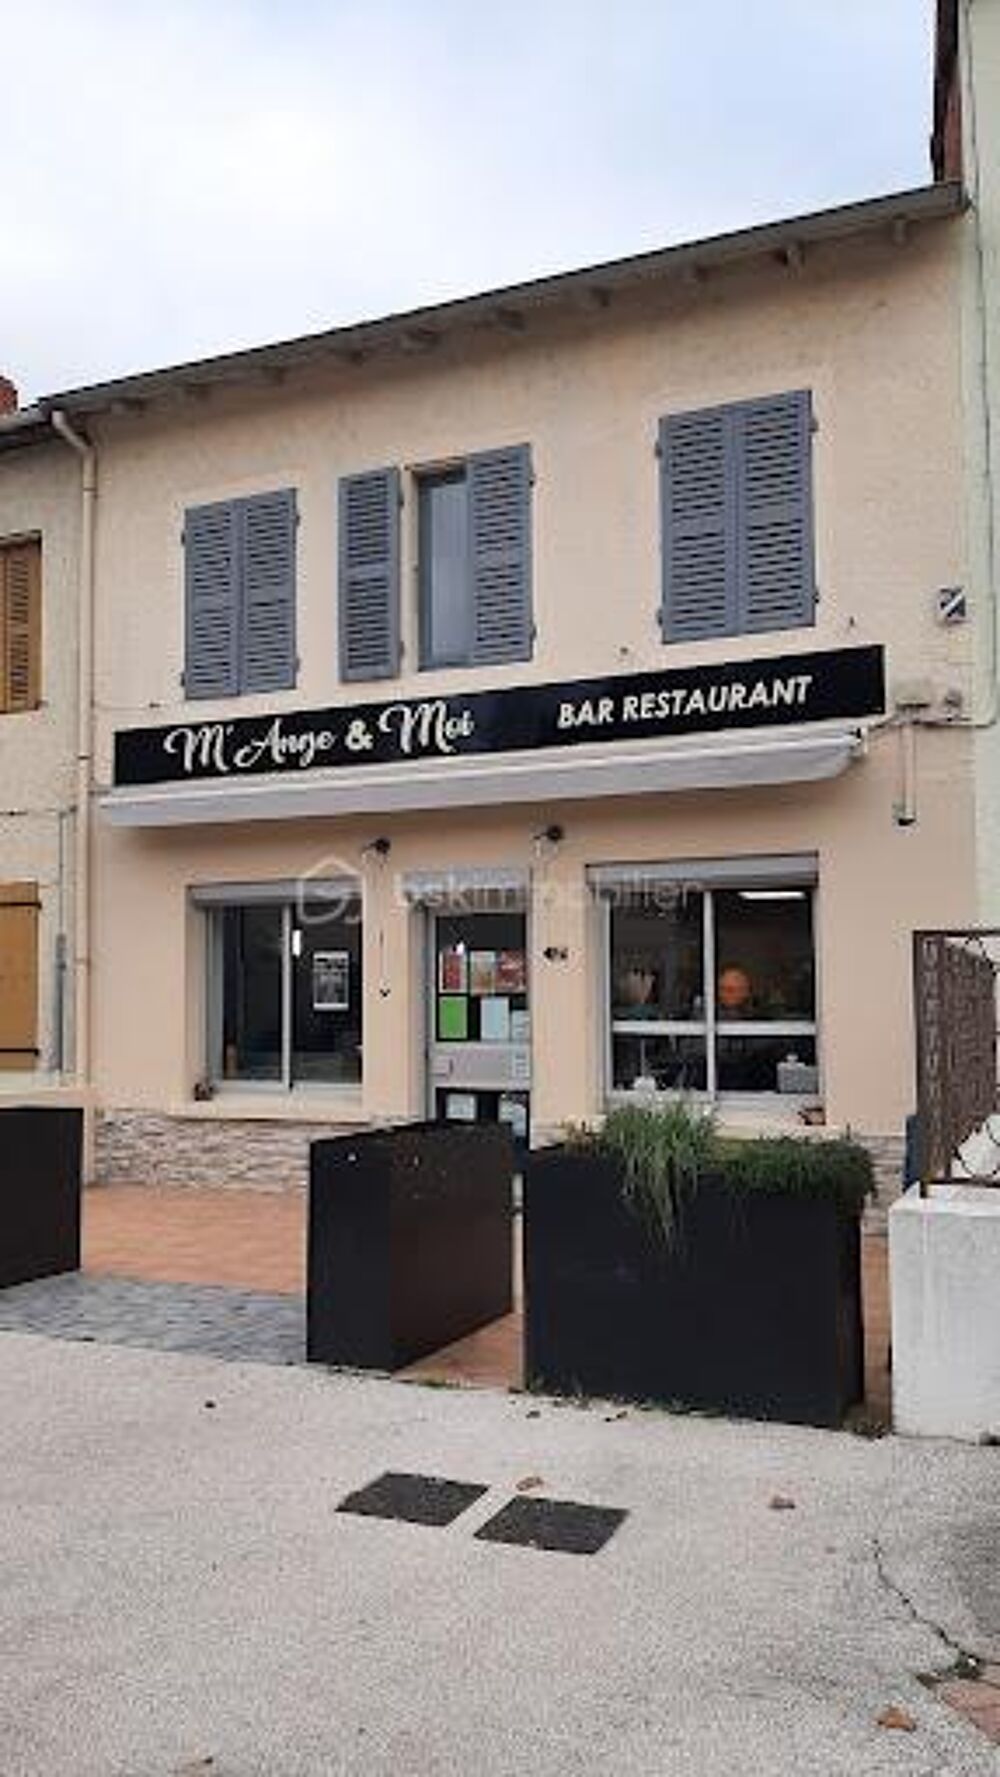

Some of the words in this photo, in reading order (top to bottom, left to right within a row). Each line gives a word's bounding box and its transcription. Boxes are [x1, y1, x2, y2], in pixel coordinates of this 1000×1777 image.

[344, 719, 374, 750] &
[378, 700, 475, 752] Moi
[557, 698, 614, 729] BAR
[622, 675, 813, 723] RESTAURANT
